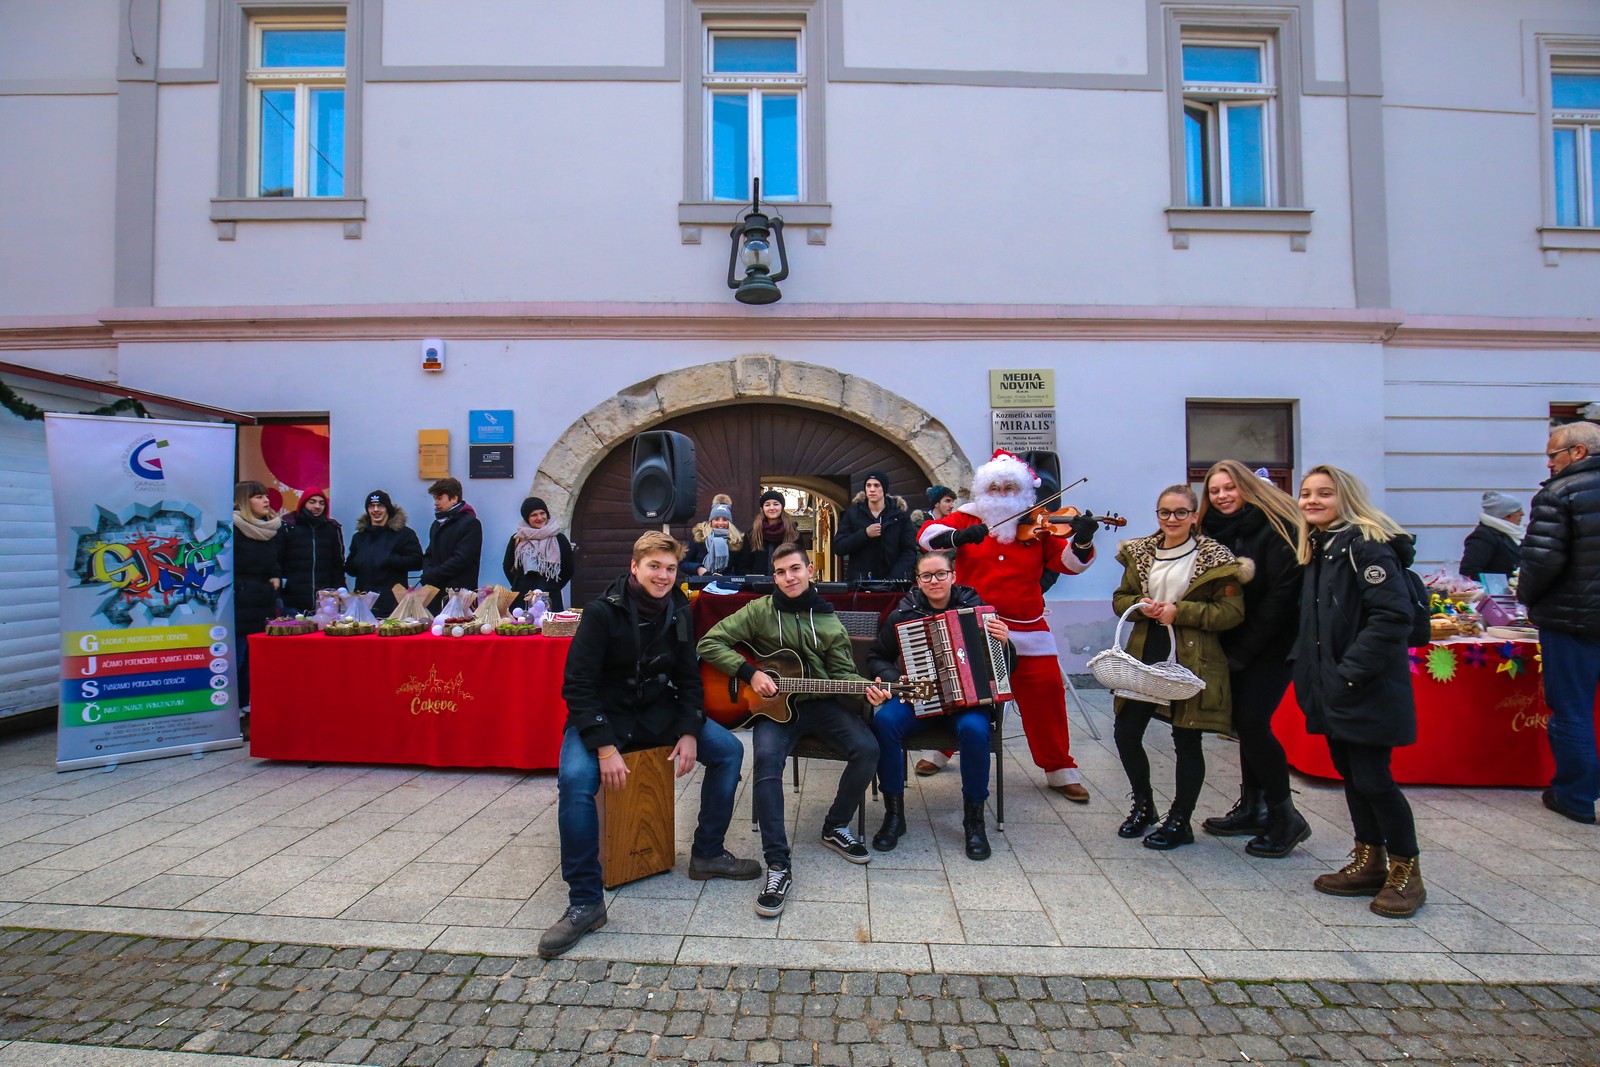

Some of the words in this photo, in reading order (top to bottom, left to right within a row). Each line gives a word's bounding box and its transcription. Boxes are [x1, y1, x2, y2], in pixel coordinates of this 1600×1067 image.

[1002, 373, 1042, 381] MEDIA
[1000, 382, 1045, 390] NOVINE
[994, 420, 1054, 430] "MIRALIS"
[410, 694, 458, 715] Čakovec
[1512, 708, 1549, 732] Čako
